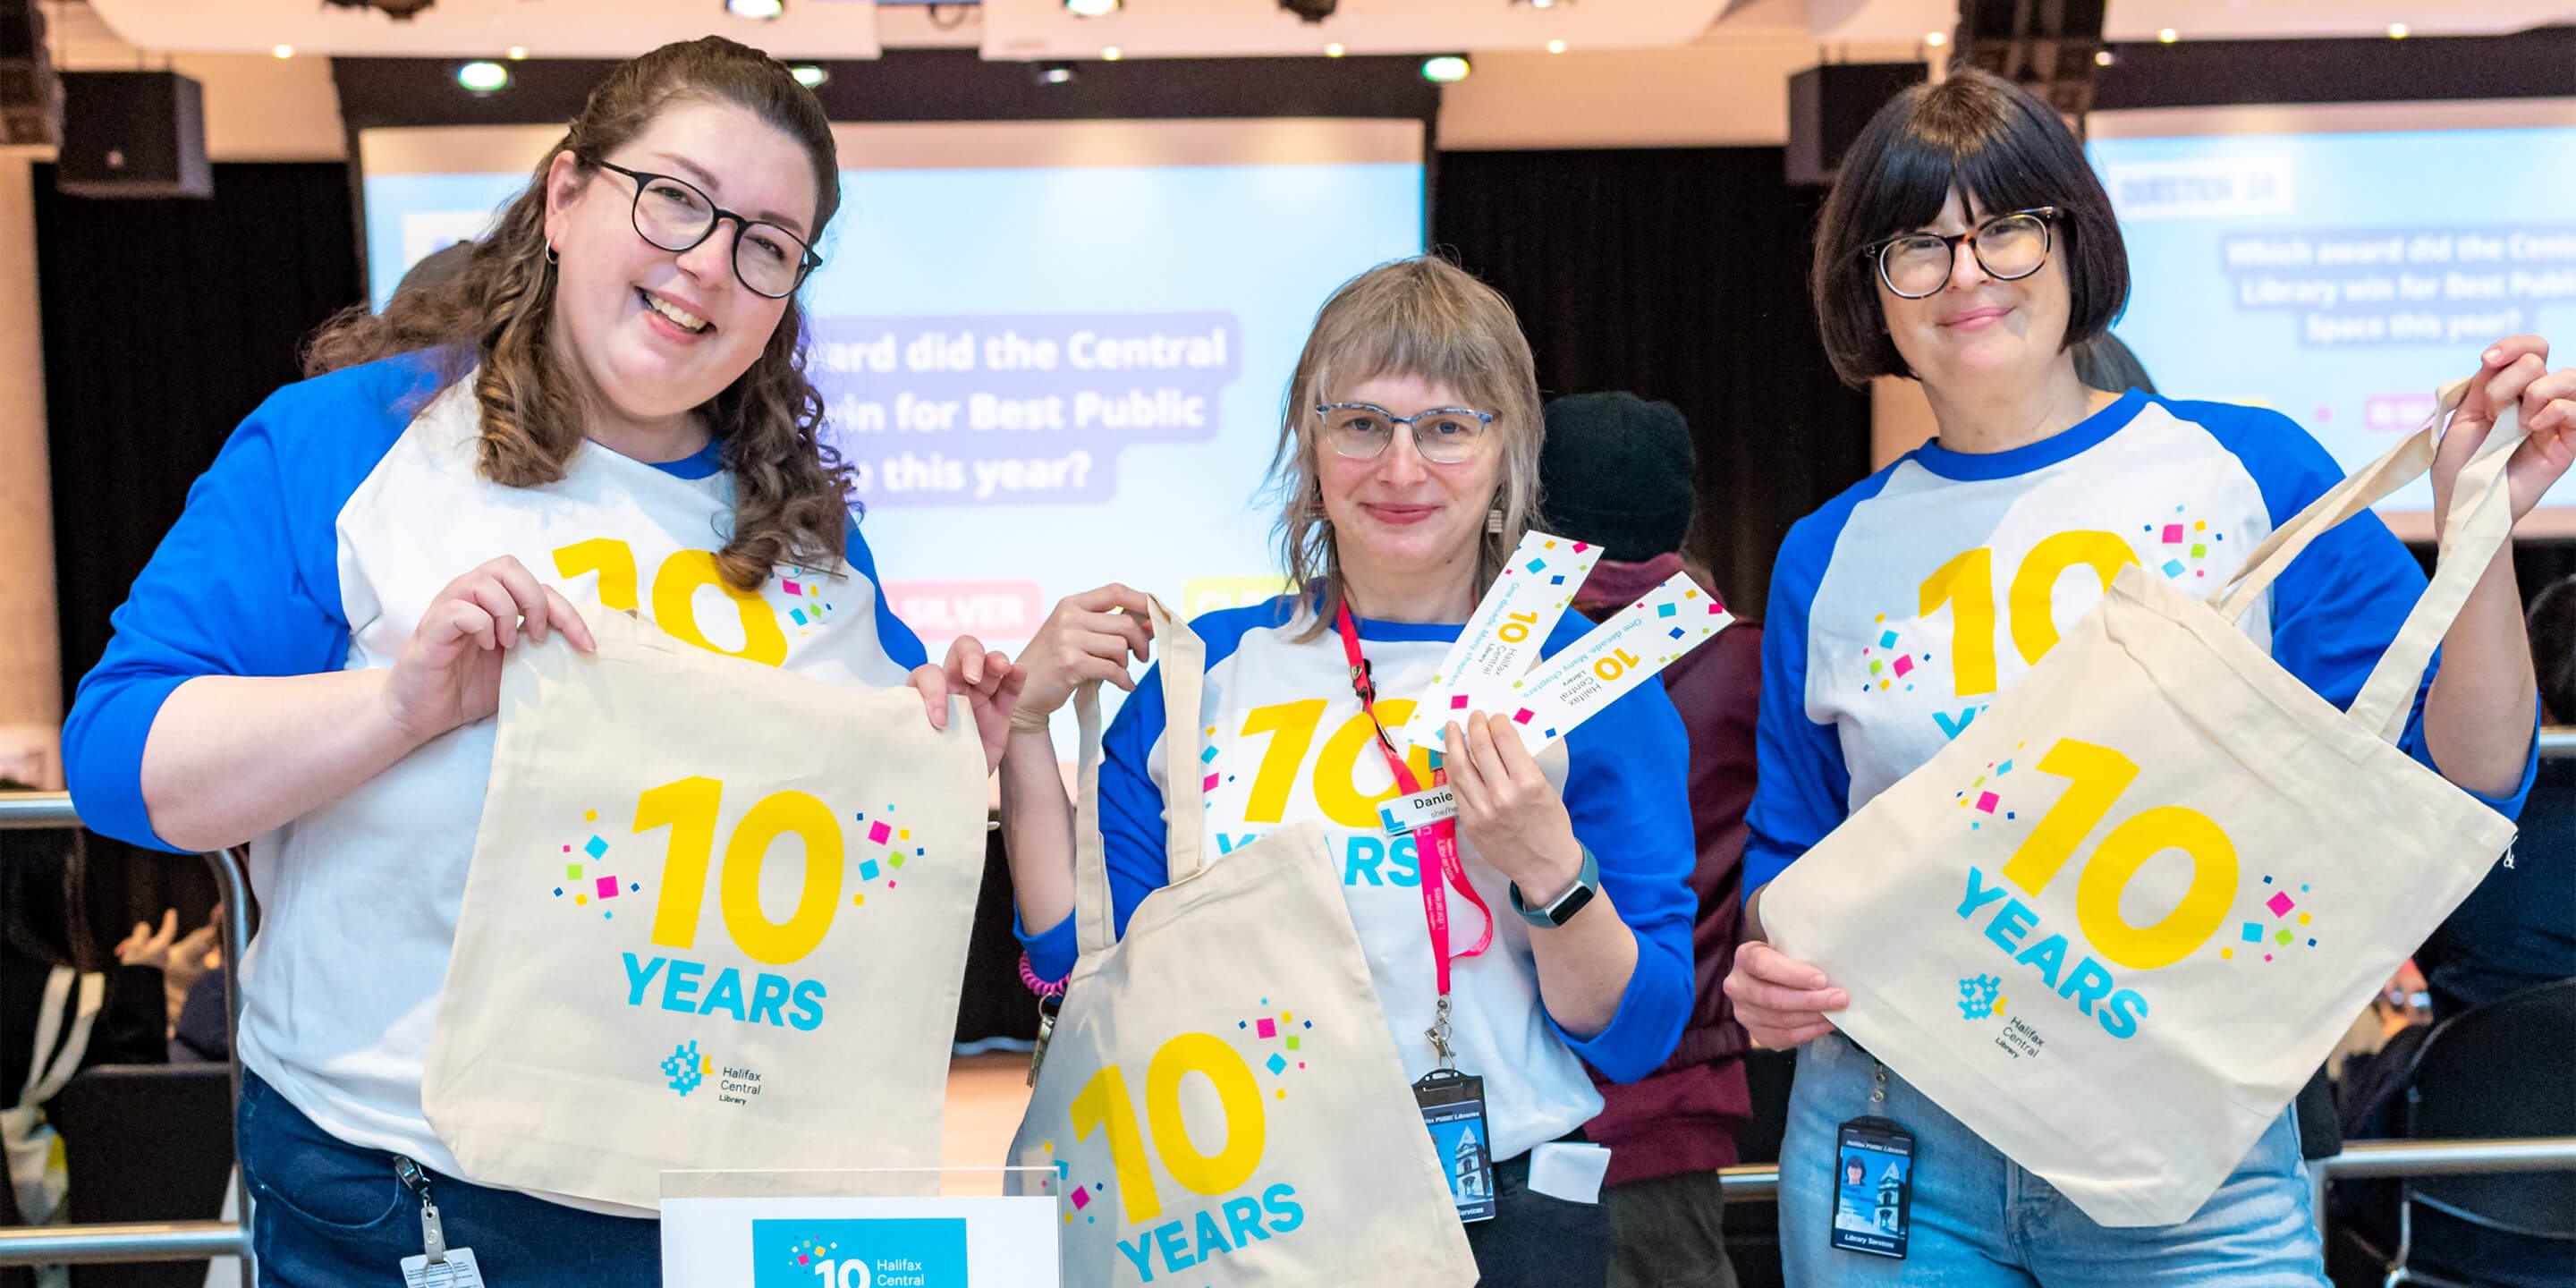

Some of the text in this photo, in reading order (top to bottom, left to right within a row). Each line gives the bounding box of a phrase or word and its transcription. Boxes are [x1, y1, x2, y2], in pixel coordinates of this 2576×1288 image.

[2226, 239, 2313, 265] Which
[2317, 235, 2404, 263] award
[2408, 234, 2453, 262] did
[2457, 233, 2503, 260] the
[2241, 275, 2338, 309] Library
[2343, 279, 2394, 301] win
[2399, 272, 2439, 300] for
[2445, 271, 2504, 298] Best
[2307, 308, 2523, 344] Space this year?
[905, 331, 975, 372] did
[985, 328, 1059, 370] the
[1067, 326, 1226, 370] Central
[895, 391, 960, 432] for
[969, 392, 1066, 430] Best
[1074, 388, 1206, 429] Public
[883, 453, 967, 493] this
[974, 451, 1092, 500] year?
[552, 538, 788, 667] 10
[1504, 582, 1520, 597] One
[901, 594, 1024, 630] SILVER
[1485, 598, 1508, 627] decade.
[1498, 612, 1538, 643] 10
[1623, 618, 1642, 632] One
[1919, 530, 2142, 697] 10
[1469, 630, 1488, 651] Many
[1589, 631, 1623, 654] decade.
[1482, 645, 1506, 675] Central
[1496, 648, 1517, 676] Halifax
[1562, 653, 1589, 672] Many
[1594, 648, 1640, 681] 10
[1559, 676, 1594, 702] Central
[1569, 683, 1602, 706] Halifax
[1240, 699, 1436, 828] 10
[1414, 792, 1453, 809] Danie
[1431, 807, 1458, 818] she/he
[1436, 839, 1455, 881] Libraries
[2002, 738, 2239, 970] 10
[632, 775, 844, 965] 10
[1434, 887, 1446, 930] Libraries
[1956, 865, 2148, 1038] YEARS
[622, 952, 827, 1031] YEARS
[2003, 1027, 2040, 1058] Central
[2010, 1016, 2045, 1047] Halifax
[1996, 1038, 2020, 1059] Library
[720, 1080, 761, 1096] Central
[722, 1066, 761, 1082] Halifax
[718, 1094, 747, 1106] Library
[1070, 1032, 1266, 1225] 10
[1116, 1183, 1304, 1283] YEARS
[815, 1258, 870, 1288] 10
[877, 1258, 922, 1271] Halifax
[877, 1274, 924, 1286] Central
